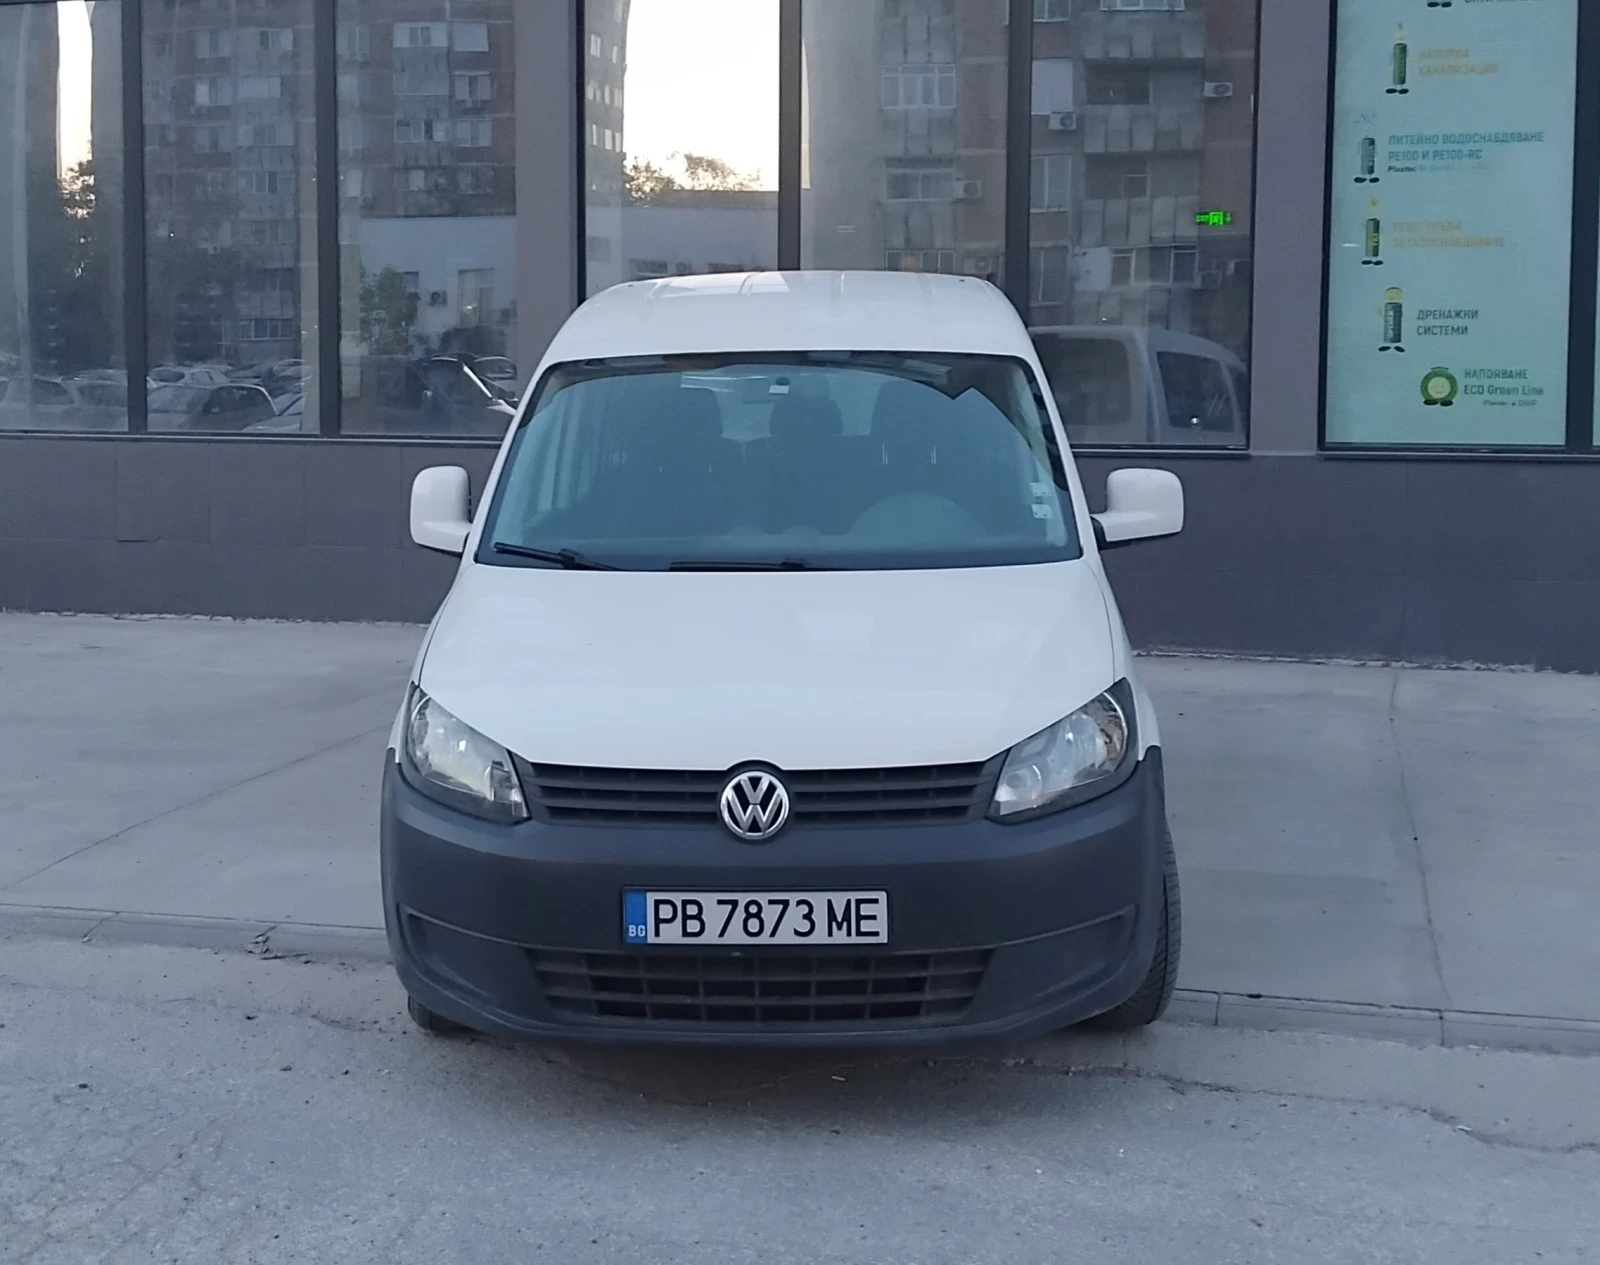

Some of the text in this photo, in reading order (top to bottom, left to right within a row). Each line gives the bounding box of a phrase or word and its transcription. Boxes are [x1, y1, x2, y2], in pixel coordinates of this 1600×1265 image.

[1388, 130, 1544, 145] ПИТЕЙНО ВОДОСНАБДЯВАНЕ
[1416, 309, 1479, 321] ДРЕНАЖНИ
[1416, 325, 1468, 336] СИСТЕМИ
[1464, 368, 1529, 380] НАПОЯВАНЕ
[1464, 384, 1544, 396] ECO Green Line
[721, 771, 789, 839] VW
[628, 898, 880, 938] BG PB 7873 ME
